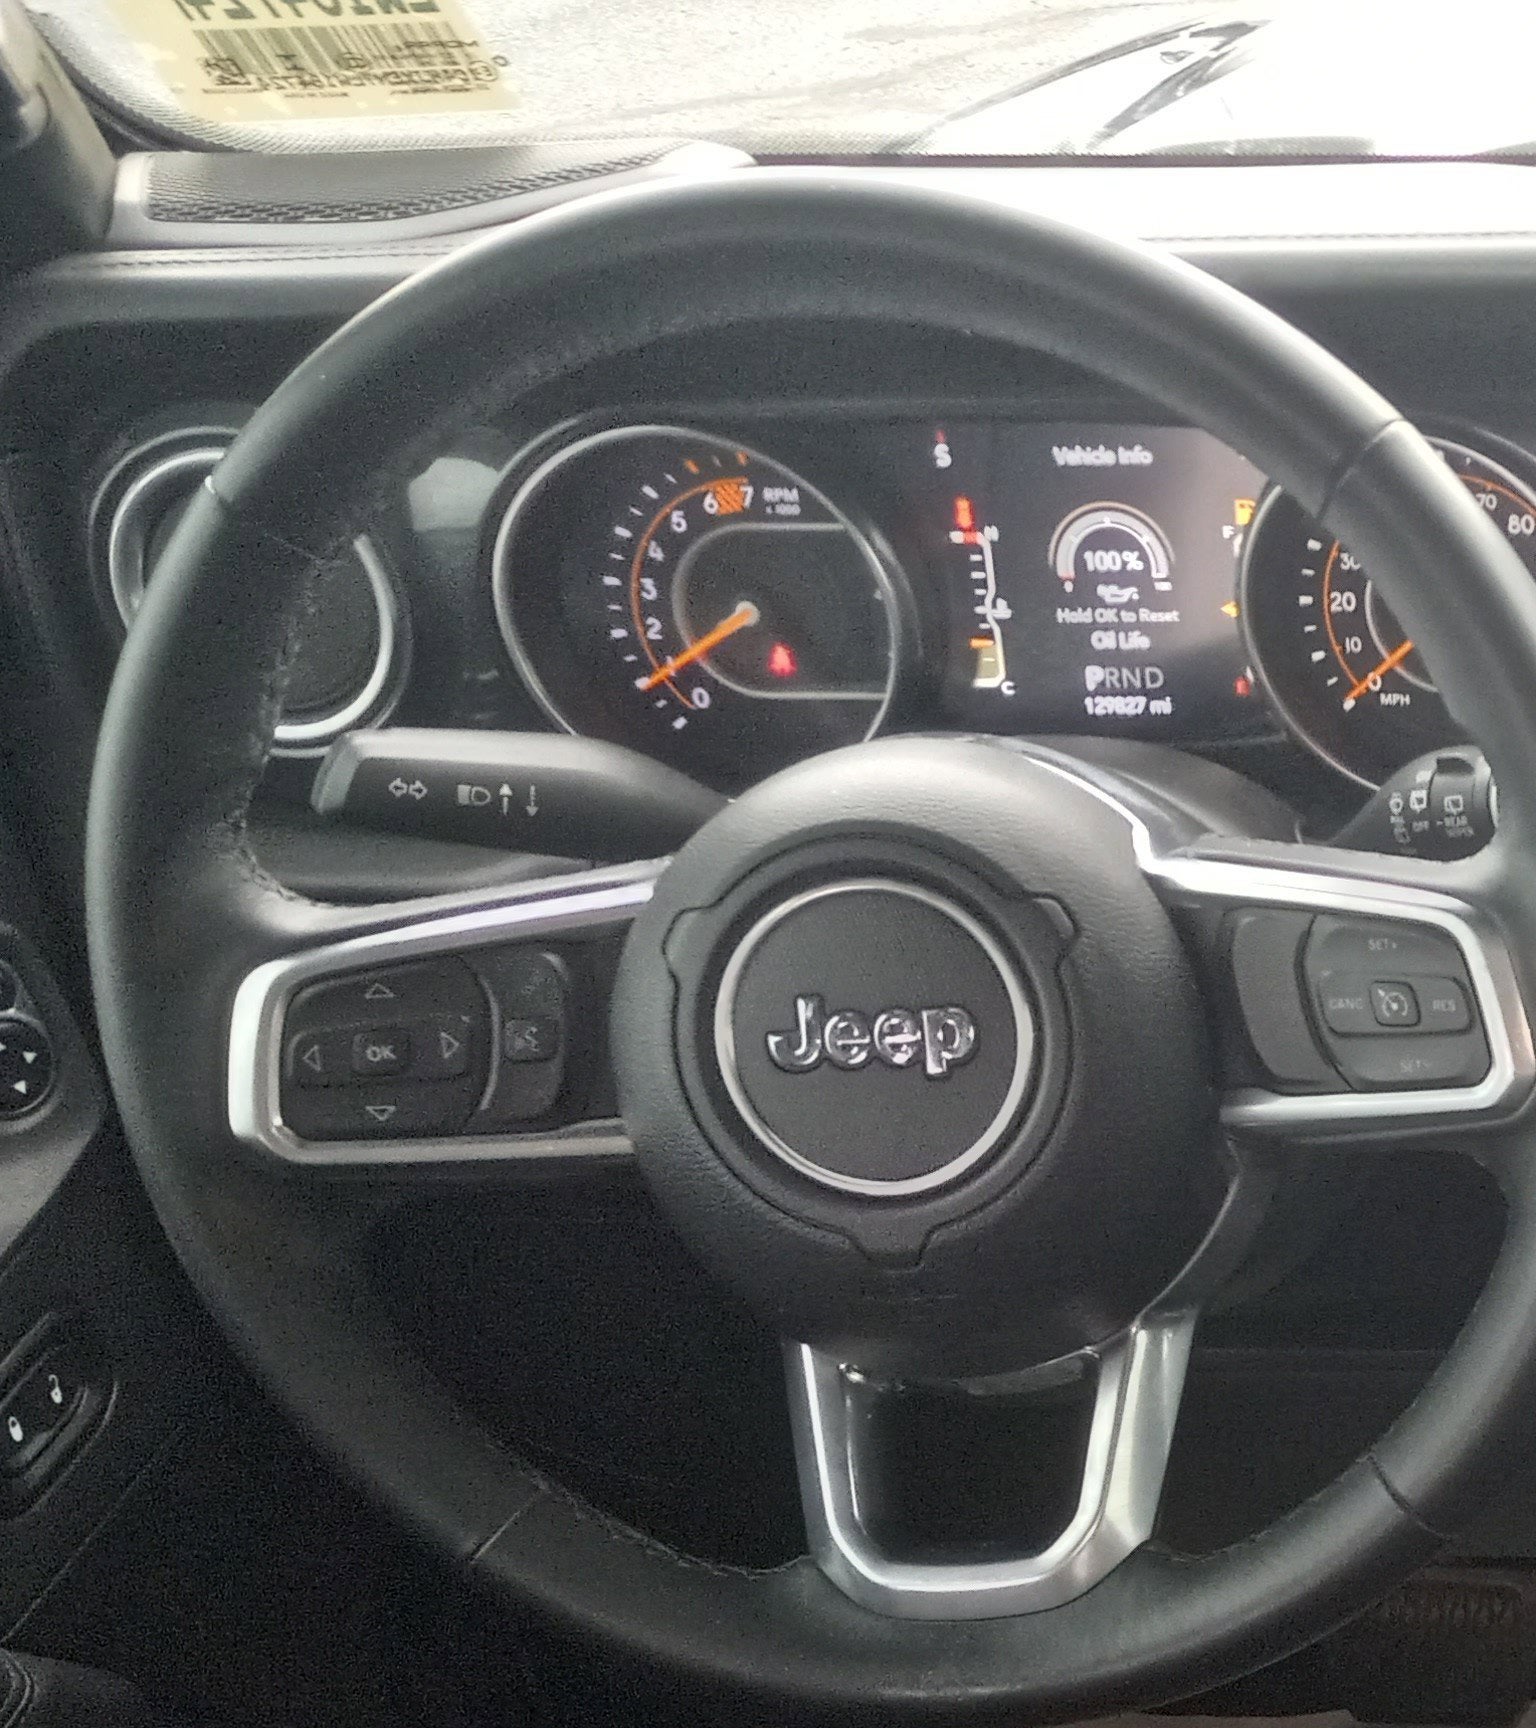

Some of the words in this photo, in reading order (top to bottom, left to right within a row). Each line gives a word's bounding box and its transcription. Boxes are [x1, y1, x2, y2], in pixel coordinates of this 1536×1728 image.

[1052, 446, 1117, 466] Vehicle
[1118, 444, 1153, 465] Info
[703, 490, 719, 514] 6
[762, 487, 799, 502] RPM
[1475, 493, 1497, 511] 70
[671, 511, 687, 533] 5
[1508, 513, 1535, 536] 80
[1083, 550, 1144, 571] 100%
[640, 577, 657, 601] 3
[1330, 591, 1357, 613] 20
[1056, 607, 1092, 623] Hold
[1094, 607, 1118, 623] OK
[1138, 607, 1179, 623] Reset
[646, 616, 662, 640] 2
[1091, 630, 1117, 650] Oil
[1118, 630, 1151, 649] Life
[1344, 636, 1362, 653] 10
[1368, 671, 1382, 691] 0
[691, 687, 710, 709] 0
[1380, 692, 1411, 706] MPH
[767, 996, 975, 1075] Jeep
[366, 1044, 396, 1061] OK
